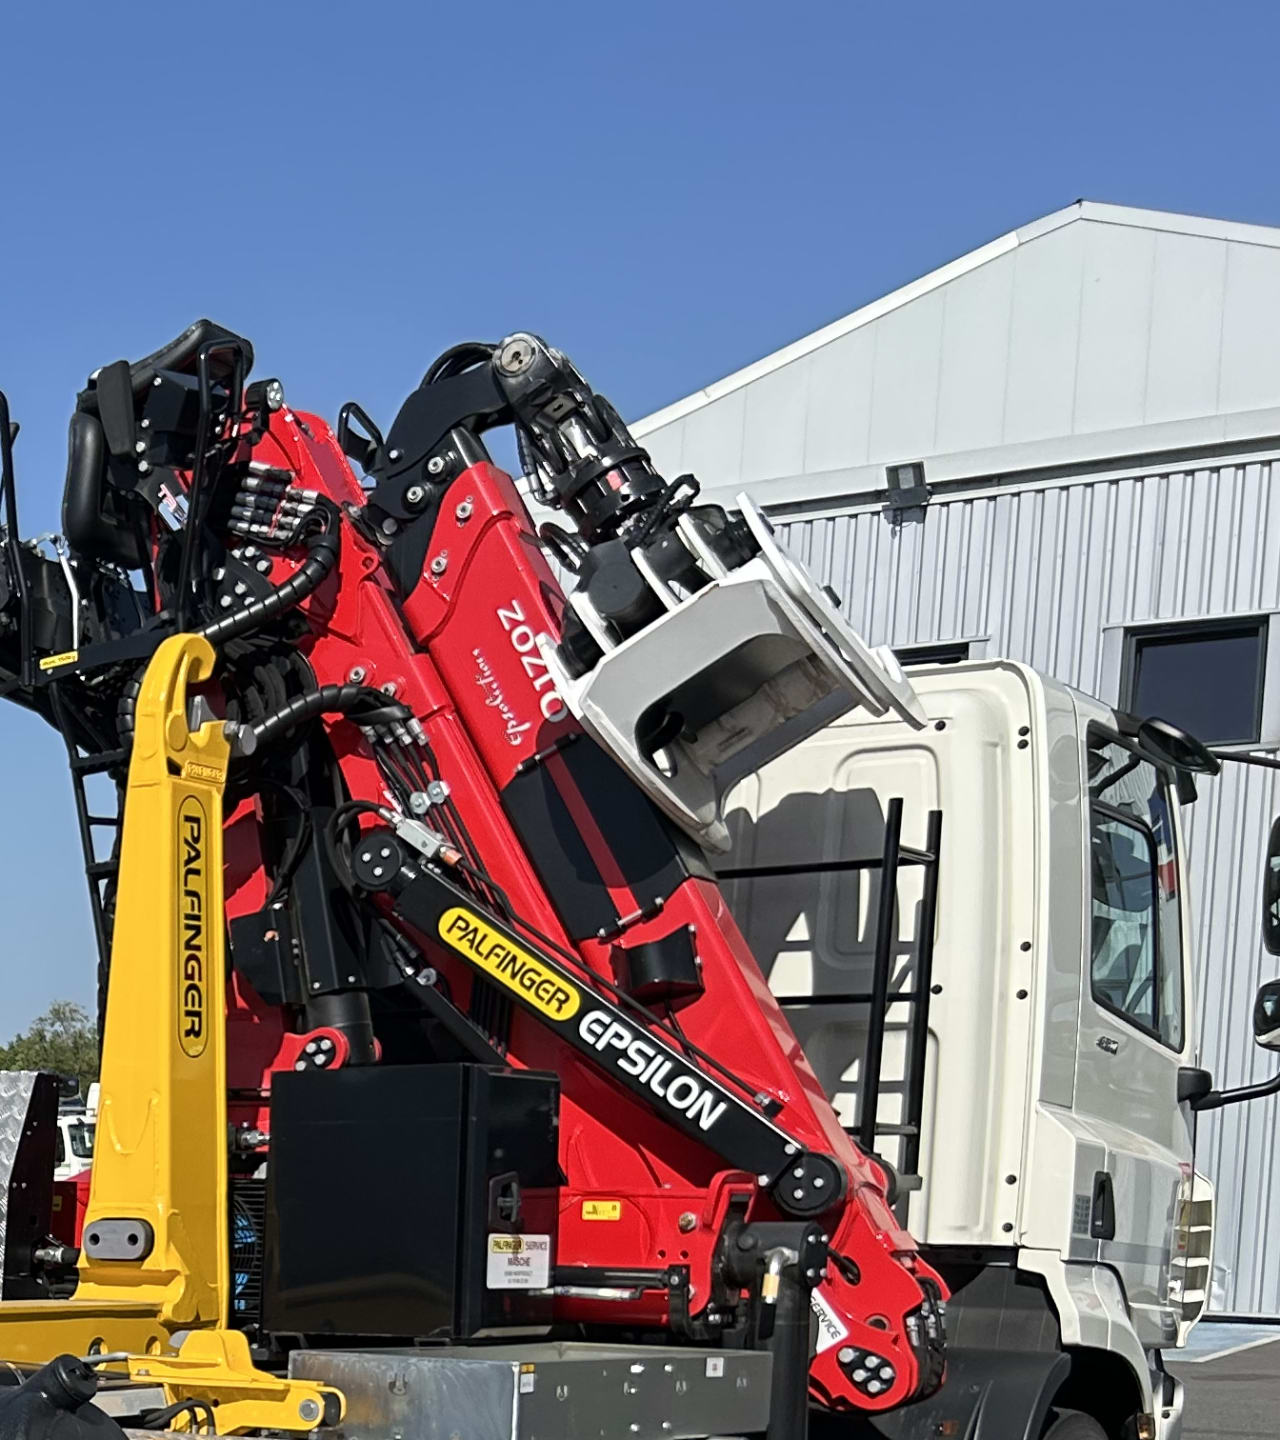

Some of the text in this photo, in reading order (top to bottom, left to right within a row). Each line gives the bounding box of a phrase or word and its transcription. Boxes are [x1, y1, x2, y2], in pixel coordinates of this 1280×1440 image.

[183, 814, 202, 1039] PALFINGER
[446, 915, 727, 1131] PALFINGER EPSILON
